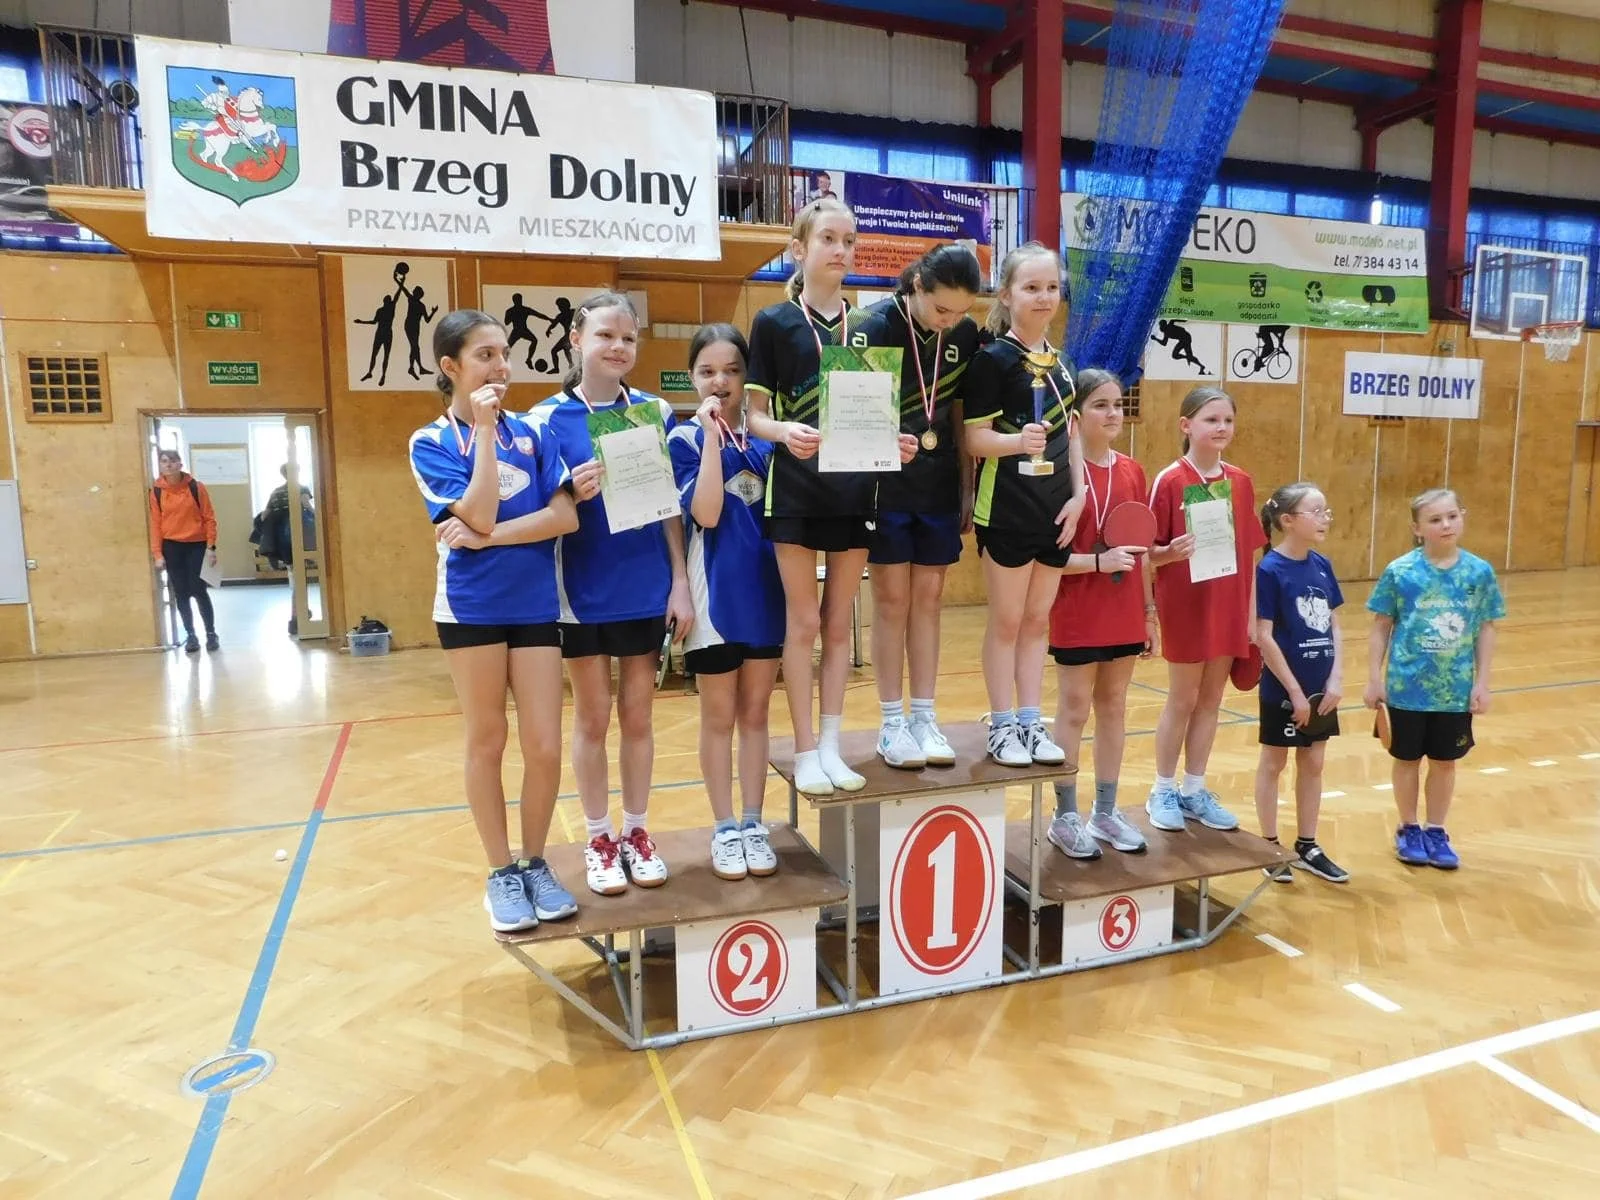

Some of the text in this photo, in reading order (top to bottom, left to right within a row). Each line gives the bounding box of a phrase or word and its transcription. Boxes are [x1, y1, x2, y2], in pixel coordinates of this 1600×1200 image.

[336, 76, 540, 137] GMINA
[340, 140, 697, 217] Brzeg Dolny
[854, 205, 909, 219] Ubezpieczymy
[910, 209, 929, 220] życie
[935, 211, 965, 223] zdrowie
[943, 190, 982, 208] Unilink
[348, 208, 696, 244] PRZYJAZNA MIESZKAŃCOM
[854, 217, 878, 228] Twoje
[882, 219, 909, 229] Twoich
[1363, 256, 1384, 269] 384
[1388, 257, 1401, 270] 43
[1405, 258, 1418, 269] 14
[211, 364, 255, 374] WYJŚCIE
[1350, 372, 1475, 400] BRZEG DOLNY
[927, 831, 958, 950] 1
[1109, 905, 1133, 945] 3
[727, 932, 768, 1003] 2
